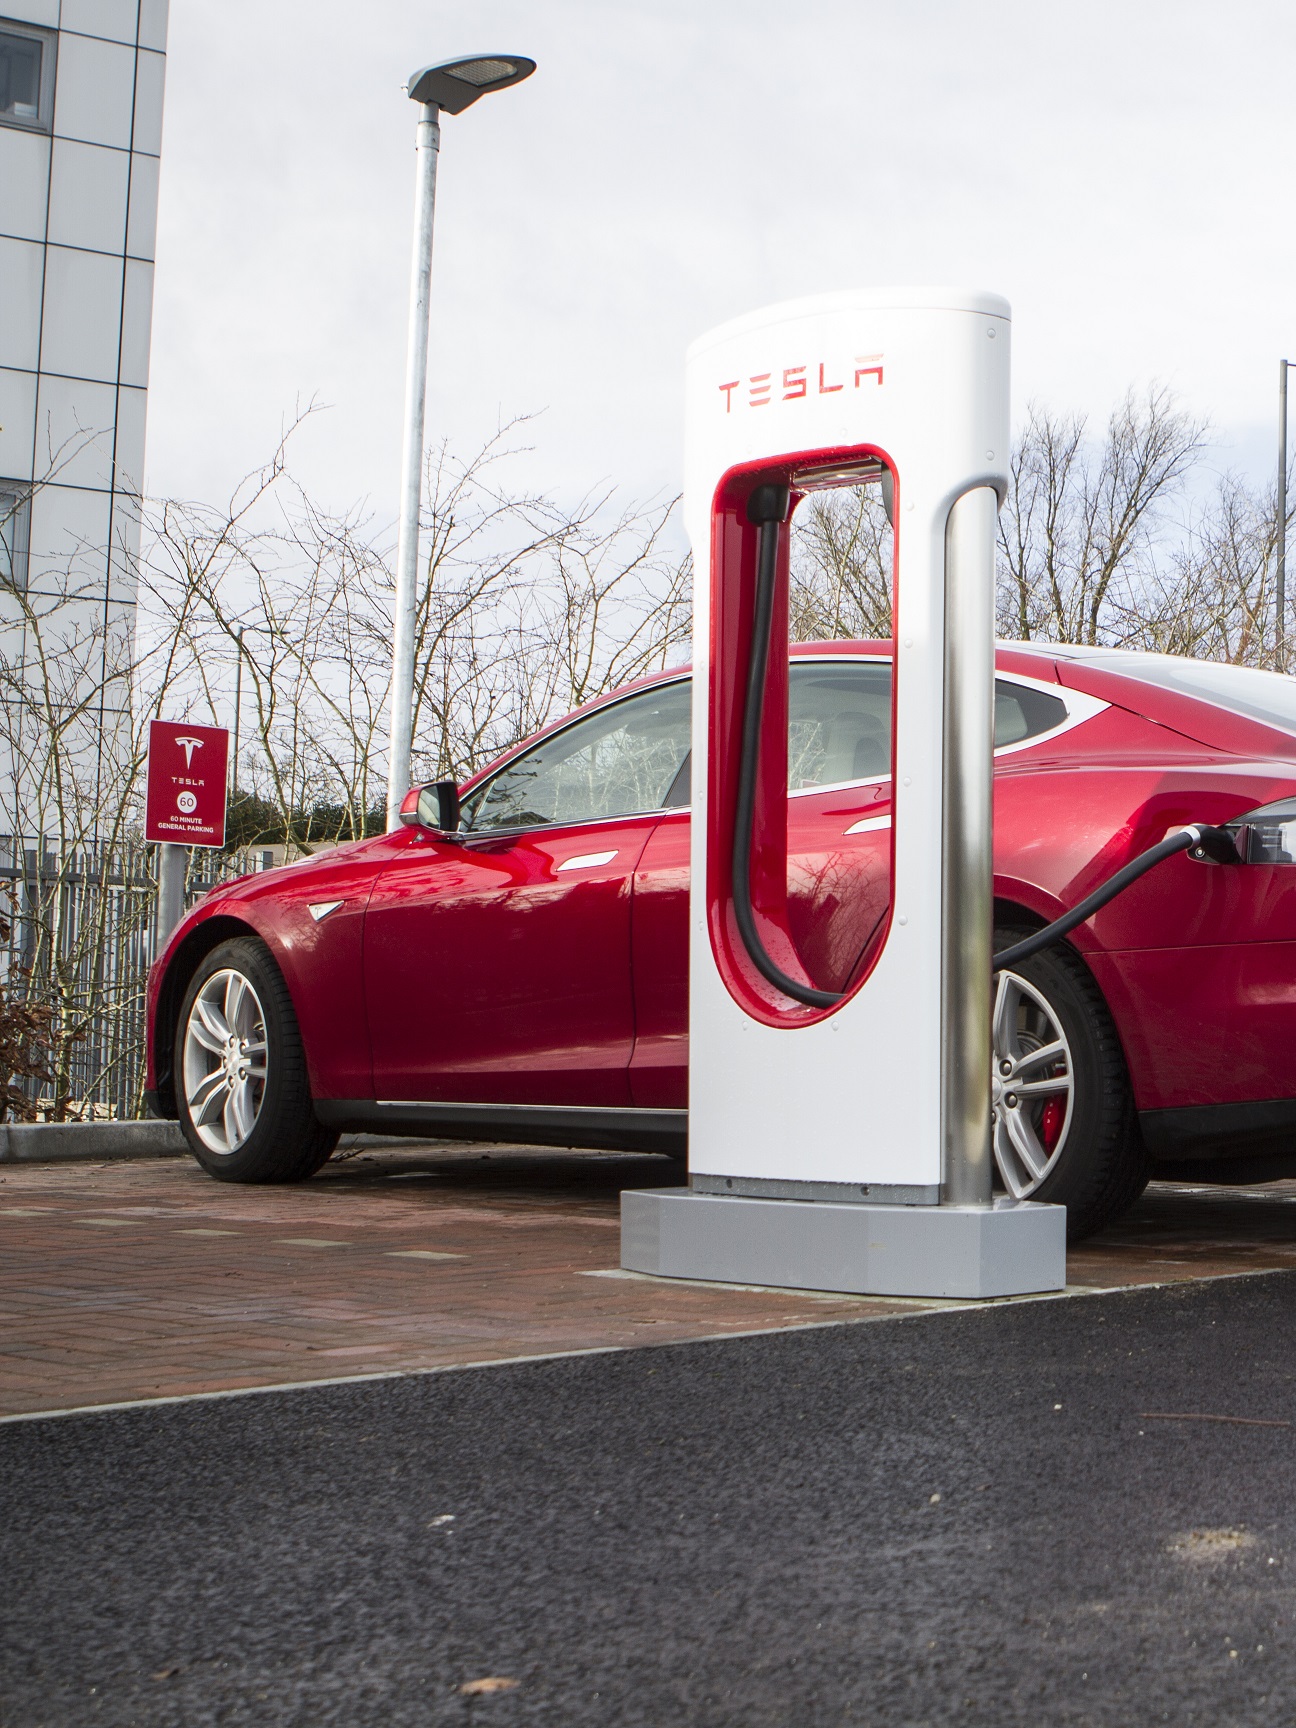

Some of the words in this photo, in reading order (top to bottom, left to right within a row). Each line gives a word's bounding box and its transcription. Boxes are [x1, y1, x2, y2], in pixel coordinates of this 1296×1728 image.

[719, 353, 884, 413] TESLA
[171, 776, 205, 787] TESLA
[180, 797, 194, 807] 60
[180, 816, 202, 824] MINUTE
[158, 822, 186, 831] GENERAL
[187, 824, 214, 834] PARKING
